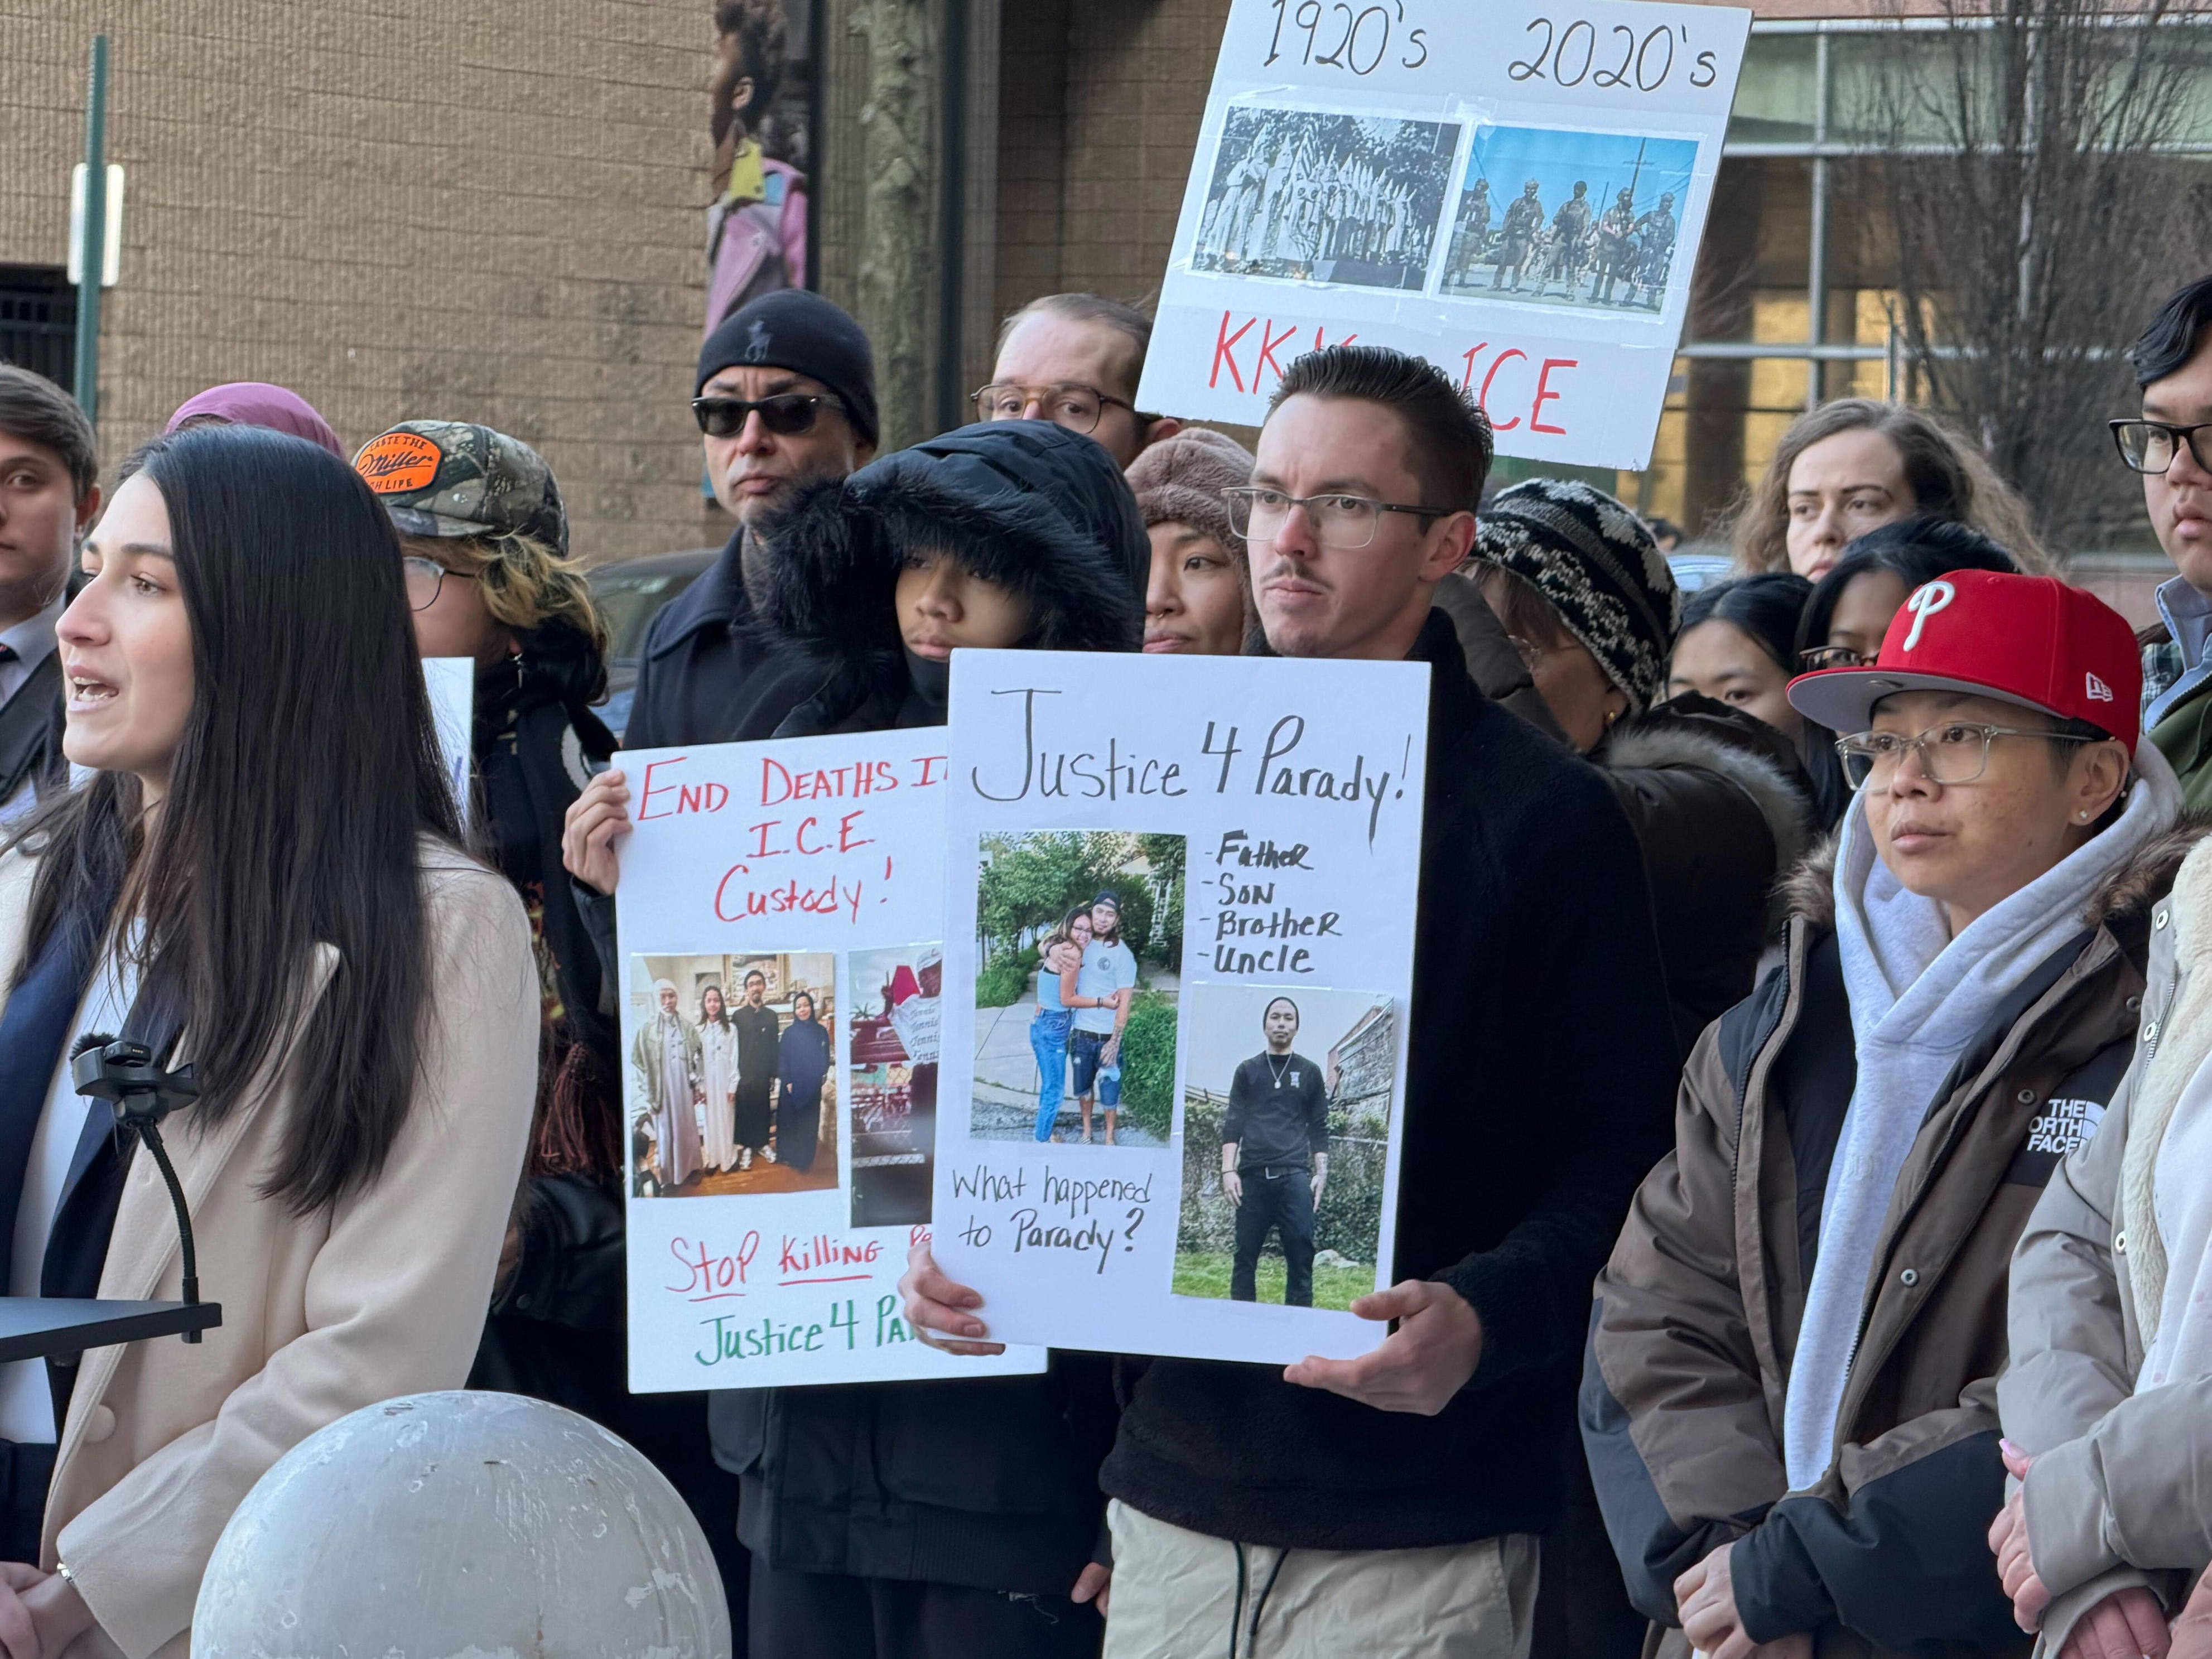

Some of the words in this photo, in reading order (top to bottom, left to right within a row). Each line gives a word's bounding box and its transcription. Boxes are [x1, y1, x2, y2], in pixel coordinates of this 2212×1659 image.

[1263, 0, 1427, 76] 1920's
[1507, 17, 1716, 92] 2020's
[1208, 310, 1358, 394] KK
[1459, 341, 1578, 435] ICE
[359, 450, 428, 475] Miller
[370, 436, 401, 451] TASTE
[403, 436, 427, 450] THE
[1903, 580, 1955, 652] P
[638, 756, 729, 821] END
[760, 757, 899, 807] DEATHS
[910, 756, 948, 787] I
[972, 688, 1188, 802] Justice
[1201, 720, 1242, 794] 4
[1255, 715, 1412, 856] Parady!
[746, 810, 875, 858] I.C.E.
[2028, 1116, 2083, 1137] ORTH
[2048, 1098, 2086, 1118] THE
[952, 1164, 1026, 1203] What
[1043, 1165, 1153, 1219] happened
[958, 1214, 992, 1248] to
[1009, 1208, 1145, 1275] Parady?
[694, 1314, 825, 1366] Justice
[829, 1299, 860, 1350] 4
